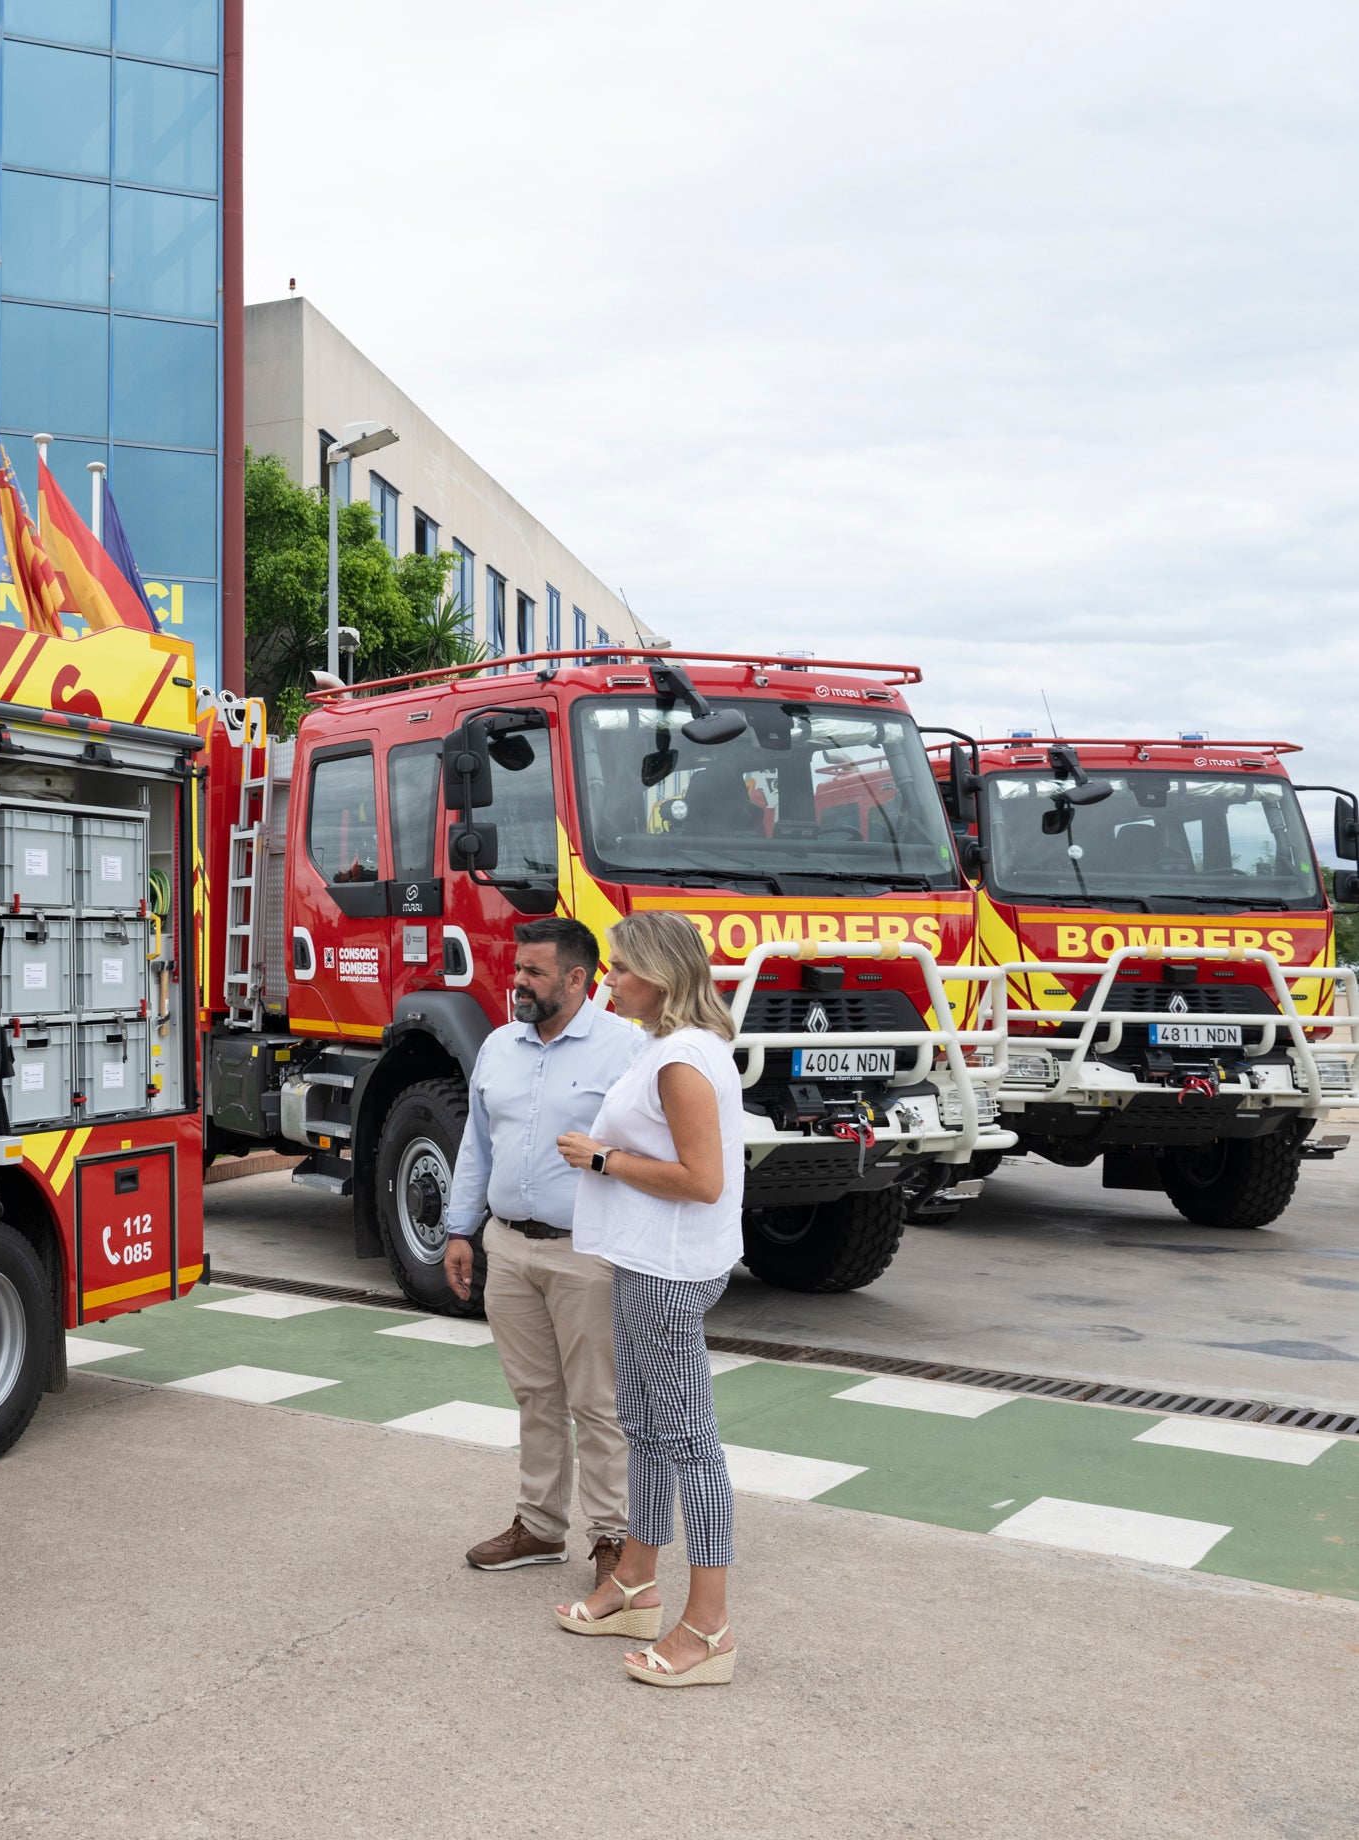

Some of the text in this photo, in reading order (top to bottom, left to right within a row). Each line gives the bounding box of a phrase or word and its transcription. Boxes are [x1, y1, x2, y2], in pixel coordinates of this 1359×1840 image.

[339, 947, 379, 961] CONSORCI
[1056, 925, 1295, 963] BOMBERS
[339, 961, 379, 975] BOMBERS
[1161, 1027, 1237, 1043] 4811 NDN
[805, 1053, 850, 1073] 4004
[856, 1053, 890, 1073] NDN
[123, 1213, 152, 1237] 112
[123, 1241, 152, 1265] 085
